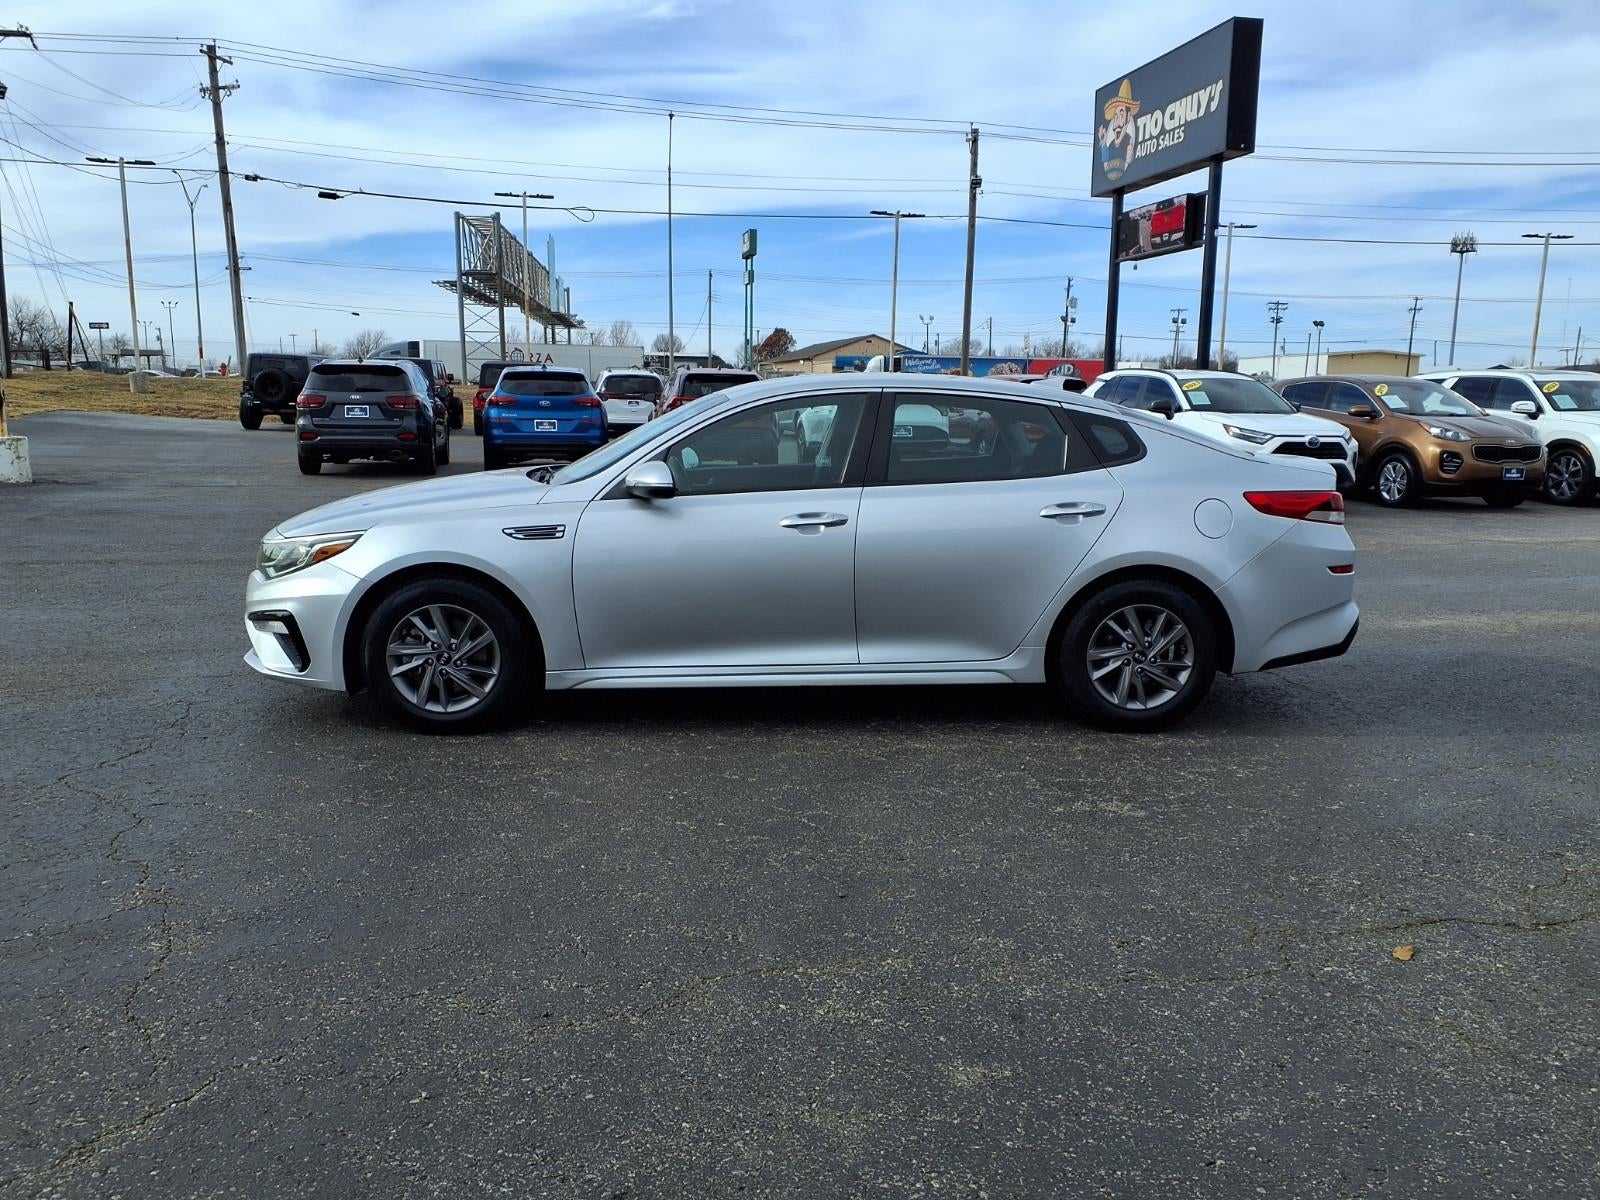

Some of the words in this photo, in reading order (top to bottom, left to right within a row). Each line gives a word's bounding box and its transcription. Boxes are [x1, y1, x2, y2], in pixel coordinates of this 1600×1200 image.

[1137, 110, 1163, 142] TIO
[1164, 79, 1224, 130] CHUY'S
[1136, 138, 1156, 159] AUTO
[1158, 126, 1185, 150] SALES
